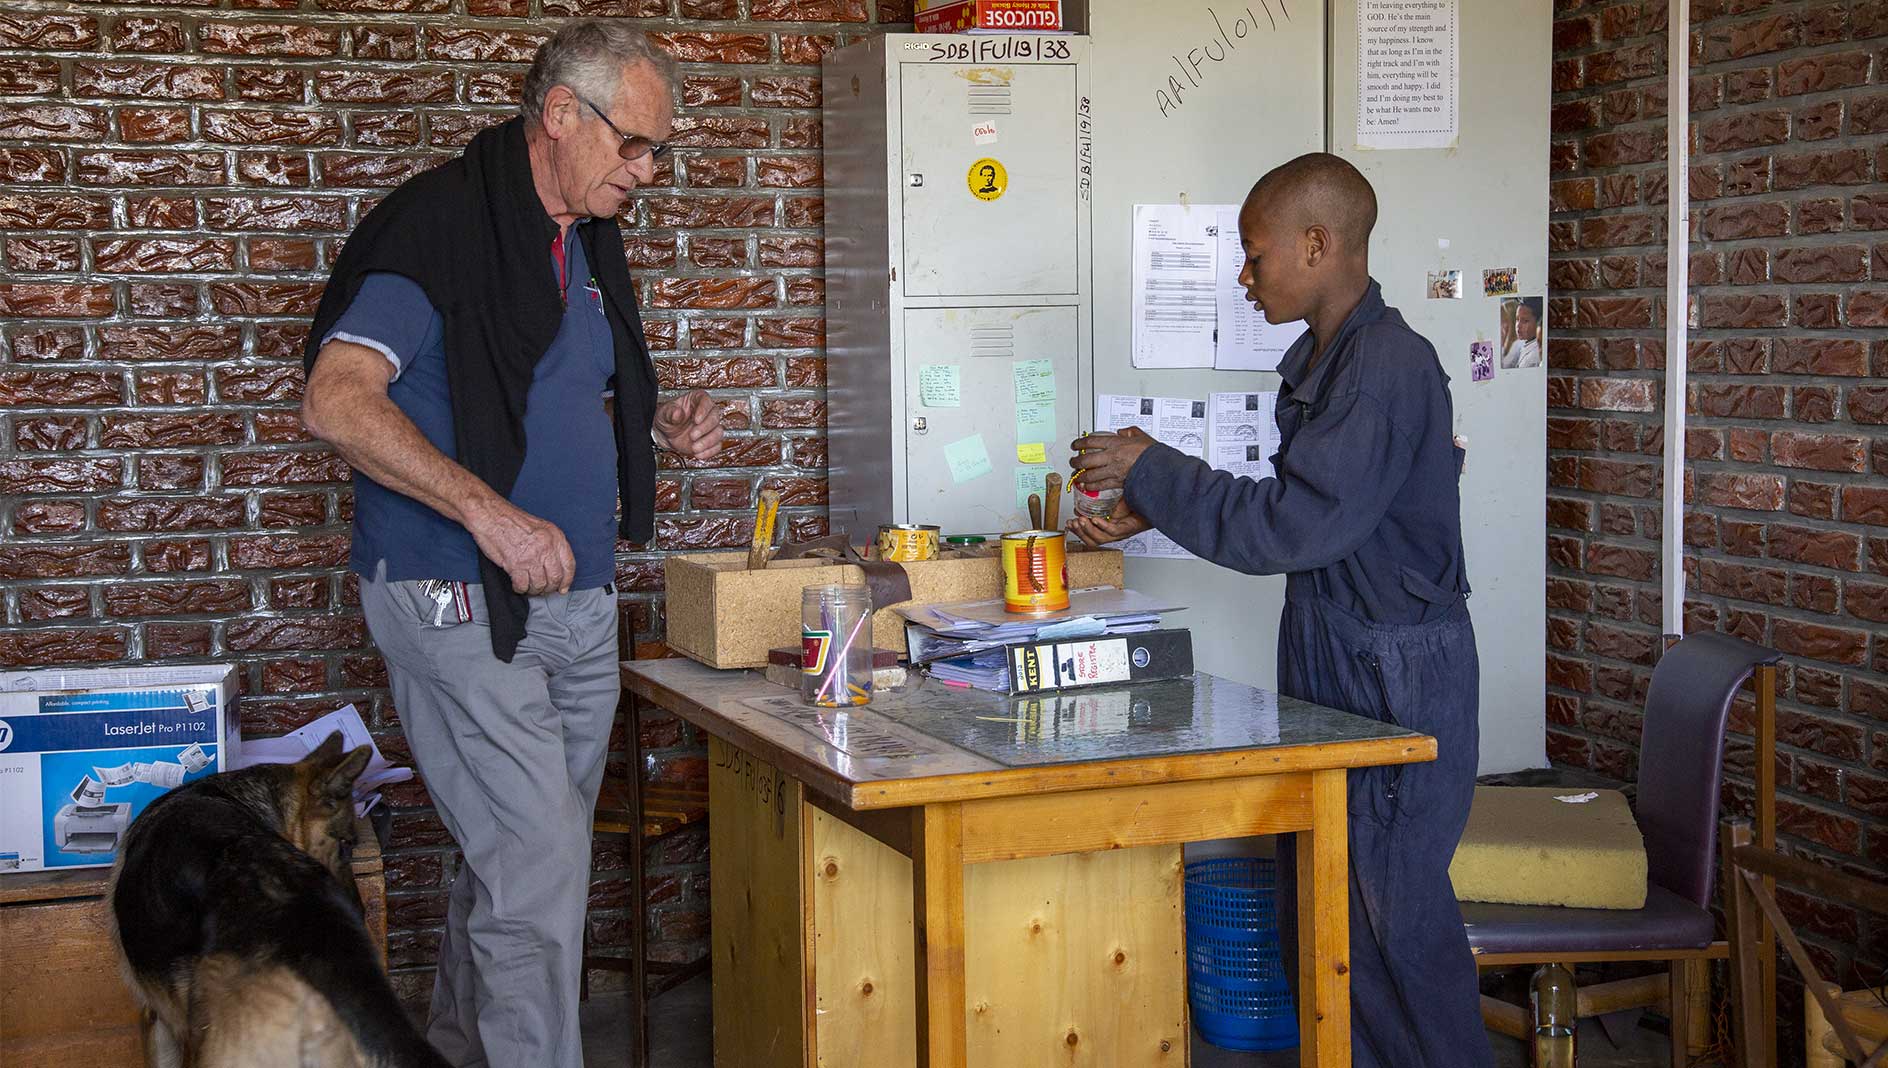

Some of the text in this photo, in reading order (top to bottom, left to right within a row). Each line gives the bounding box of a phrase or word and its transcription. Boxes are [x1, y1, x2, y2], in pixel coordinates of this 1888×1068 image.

[1380, 1, 1403, 10] leaving
[1405, 1, 1437, 10] everything
[985, 10, 1056, 27] GLUCOSE
[1397, 26, 1406, 34] my
[1409, 24, 1434, 33] strength
[1367, 38, 1377, 46] my
[1417, 36, 1433, 44] know
[1367, 48, 1379, 56] that
[1389, 48, 1403, 57] long
[1433, 47, 1442, 55] the
[1367, 60, 1382, 69] right
[1400, 59, 1411, 67] and
[1426, 59, 1440, 67] with
[1382, 71, 1415, 80] everything
[1417, 70, 1429, 78] will
[1430, 70, 1438, 78] be
[1367, 82, 1389, 90] smooth
[1391, 82, 1402, 90] and
[1430, 81, 1440, 89] did
[1366, 94, 1378, 102] and
[1392, 93, 1410, 103] doing
[1412, 95, 1421, 103] my
[1423, 93, 1435, 101] best
[1366, 106, 1374, 114] be
[1392, 105, 1401, 113] He
[1078, 652, 1086, 678] STORE
[1088, 643, 1099, 679] REGISTER
[1026, 650, 1038, 687] KENT
[104, 721, 206, 736] LaserJet Pro P1102
